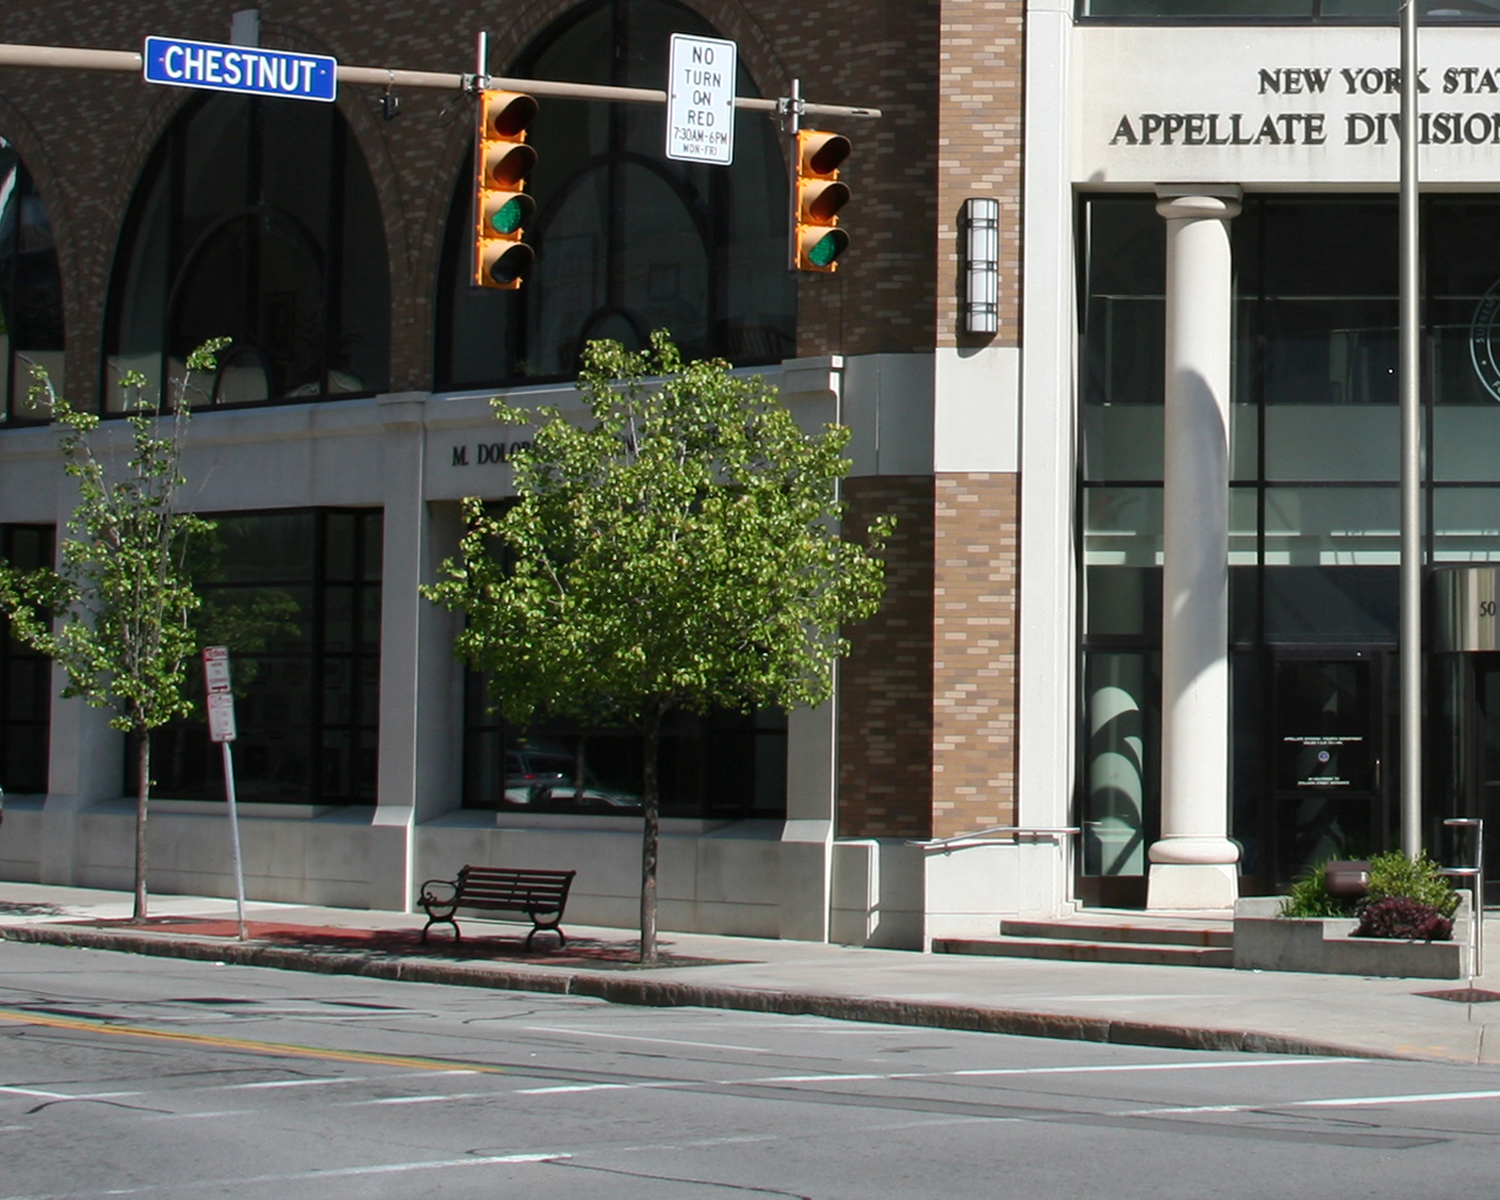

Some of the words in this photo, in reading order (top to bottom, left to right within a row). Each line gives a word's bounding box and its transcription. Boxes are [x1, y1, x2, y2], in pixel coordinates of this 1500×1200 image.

[692, 46, 714, 65] NO
[164, 45, 317, 93] CHESTNUT
[684, 68, 721, 88] TURN
[1257, 67, 1333, 95] NEW
[1340, 67, 1432, 95] YORK
[692, 90, 711, 107] ON
[687, 109, 715, 127] RED
[1108, 113, 1328, 146] APPELLATE
[452, 445, 469, 467] M.
[1479, 601, 1496, 617] 50
